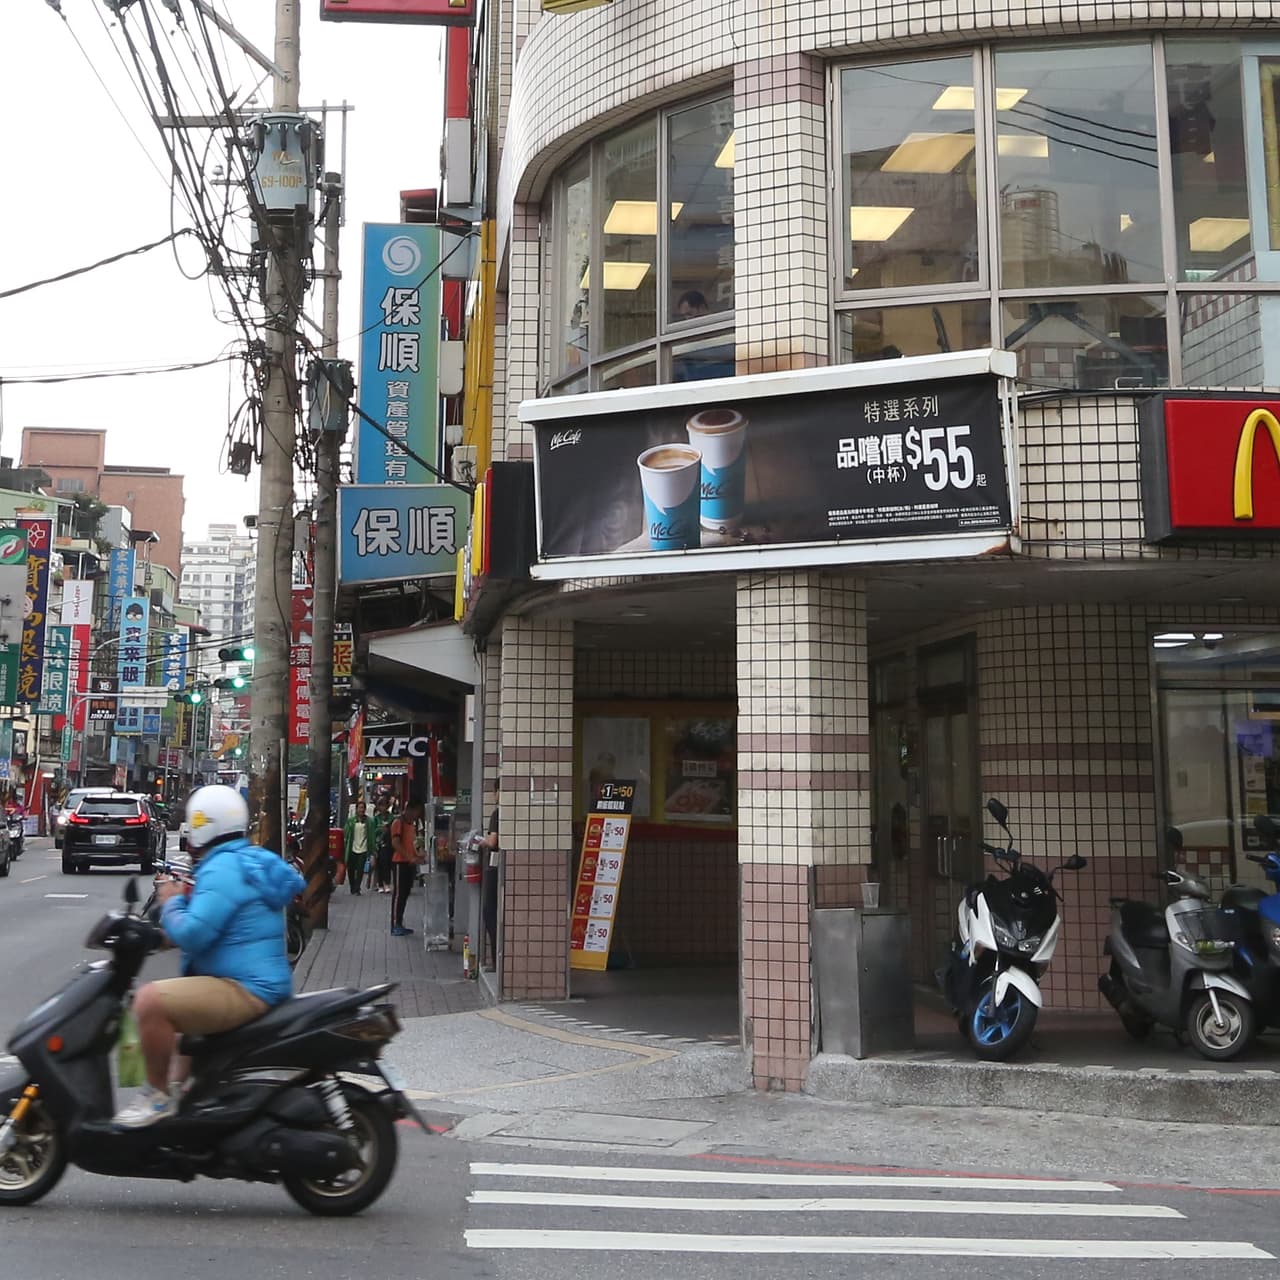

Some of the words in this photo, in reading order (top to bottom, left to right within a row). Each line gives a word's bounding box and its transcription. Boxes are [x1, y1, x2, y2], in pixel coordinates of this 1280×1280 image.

[377, 286, 420, 373] 保順
[384, 380, 410, 484] 資產管理有
[864, 395, 939, 423] 特選系列
[352, 506, 457, 556] 保順
[366, 736, 429, 757] KFC
